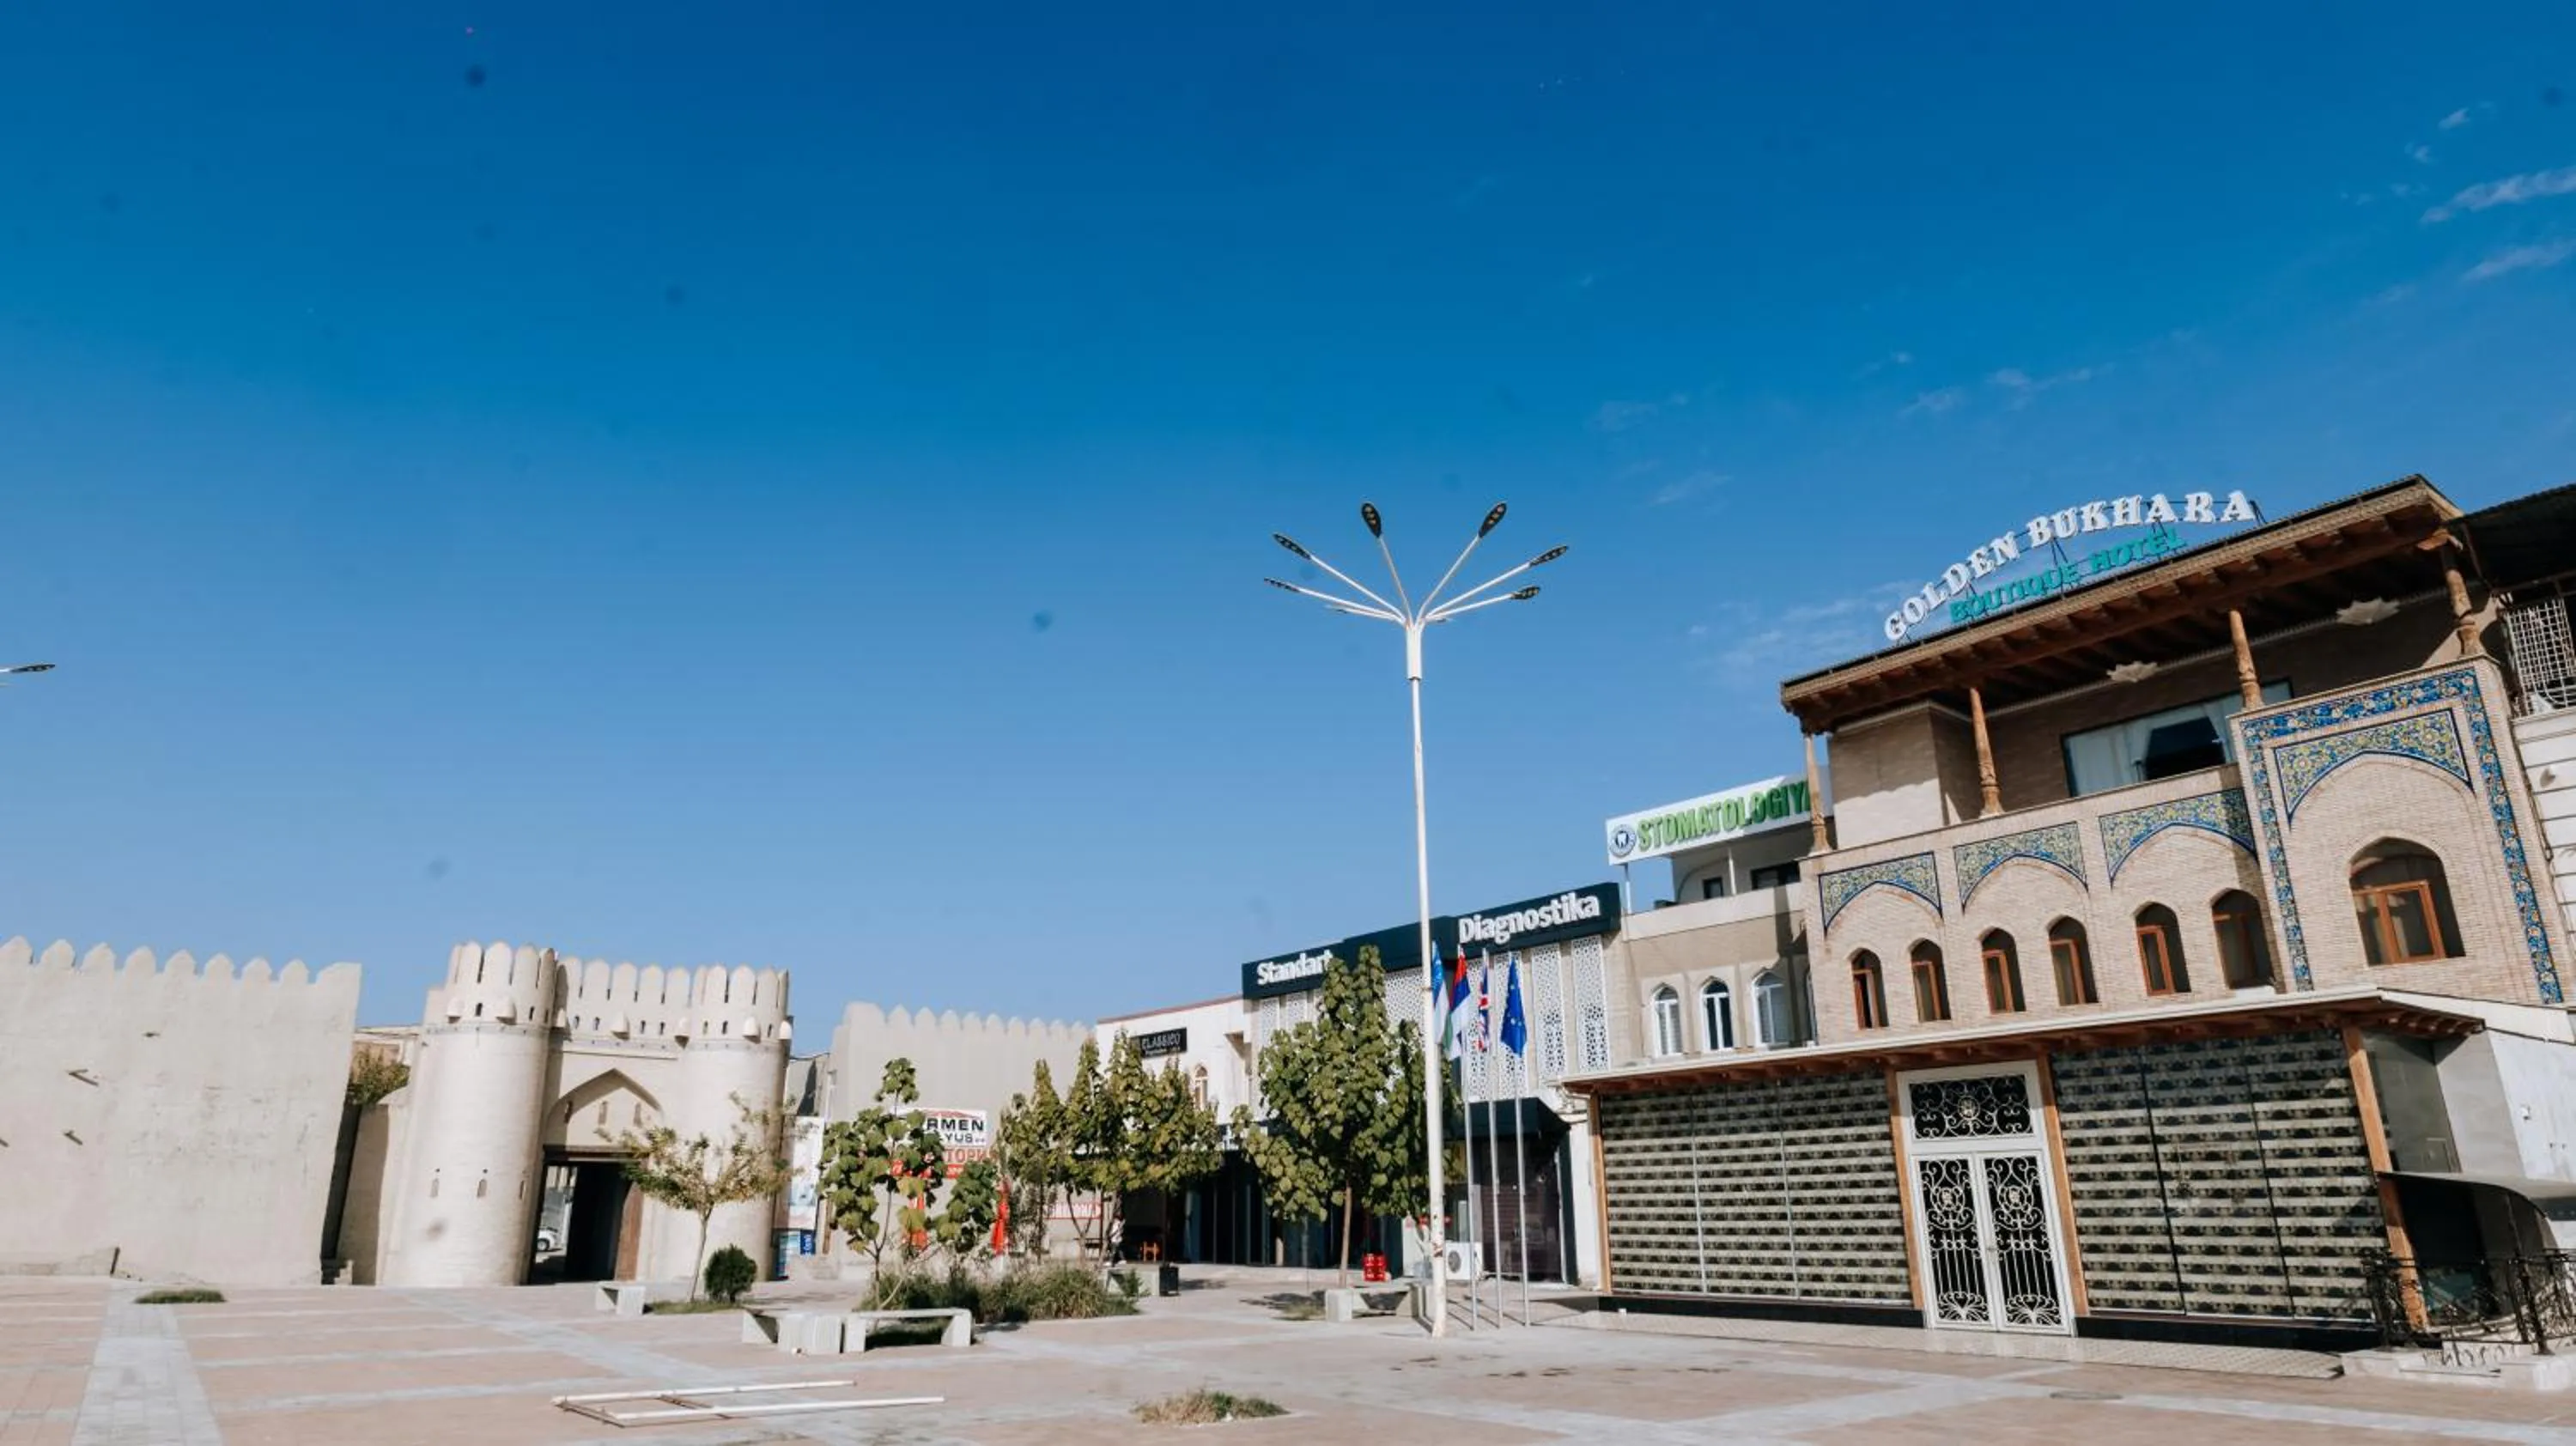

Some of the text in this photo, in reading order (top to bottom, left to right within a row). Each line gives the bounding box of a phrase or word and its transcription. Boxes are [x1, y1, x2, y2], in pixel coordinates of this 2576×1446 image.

[1885, 490, 2256, 641] GOLDEN BUKHARA
[1949, 527, 2187, 622] BOUTIQUE HOTEL
[1256, 891, 1600, 985] Standart Diagnostika
[926, 1118, 984, 1131] RMEN
[945, 1133, 973, 1143] YUS
